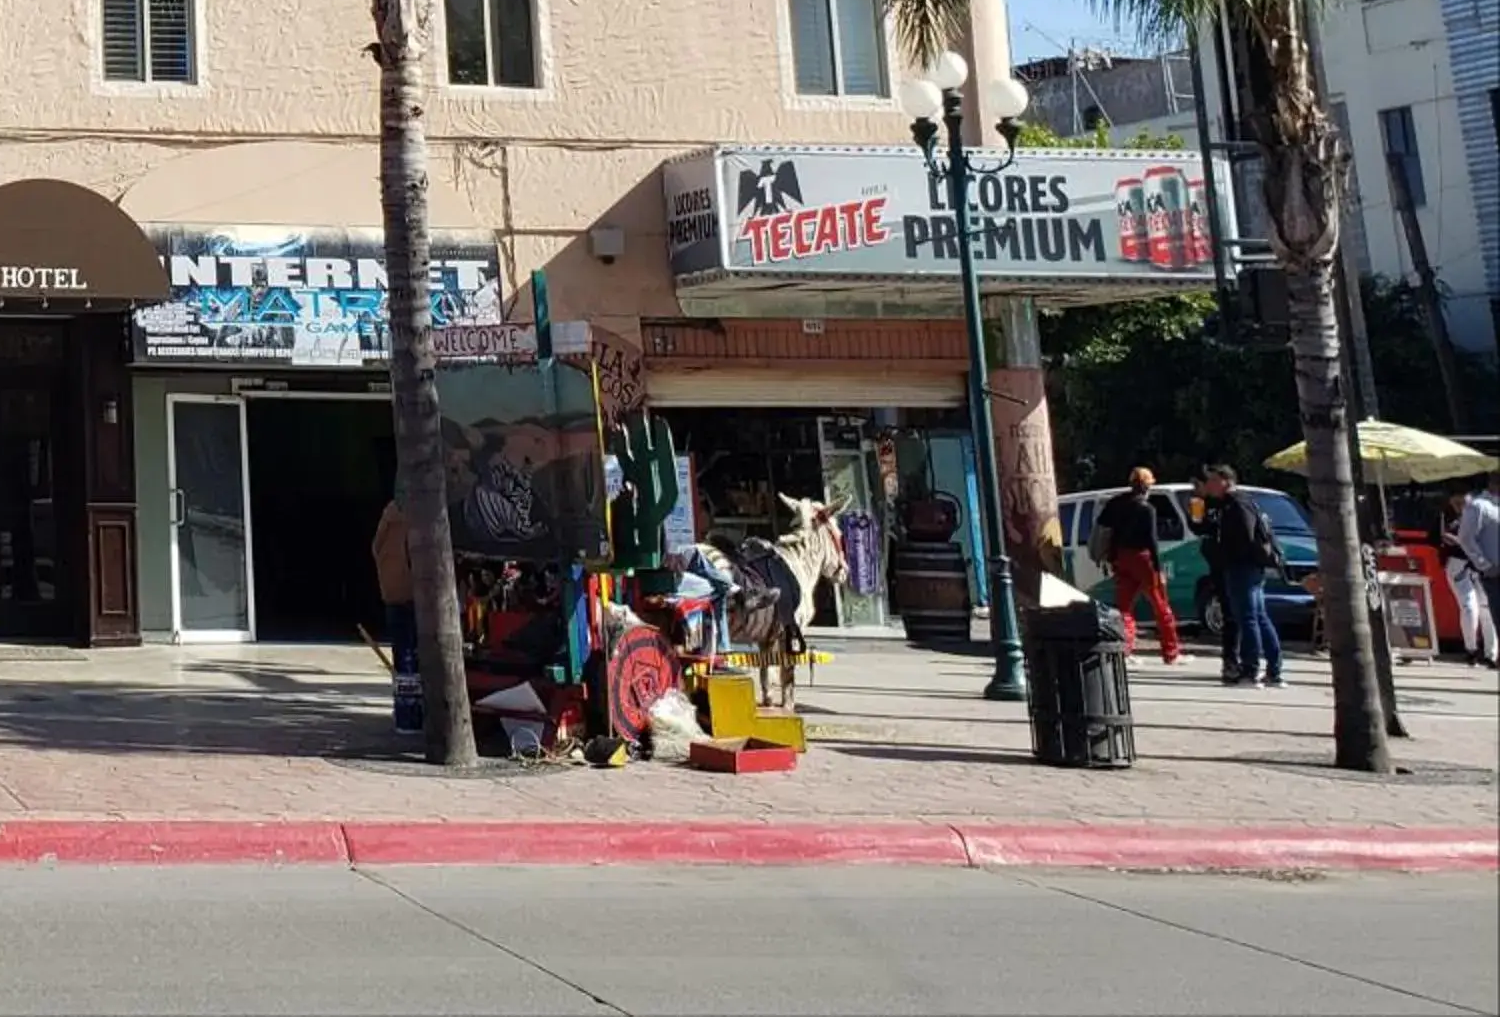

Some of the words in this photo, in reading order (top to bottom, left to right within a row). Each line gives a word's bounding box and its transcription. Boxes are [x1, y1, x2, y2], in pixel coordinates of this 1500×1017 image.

[738, 196, 891, 264] TECATE
[903, 214, 1107, 263] PREMIUM
[0, 266, 88, 290] HOTEL
[159, 254, 489, 290] NTERNT
[199, 289, 454, 326] MATRX
[433, 327, 518, 353] WELCOME
